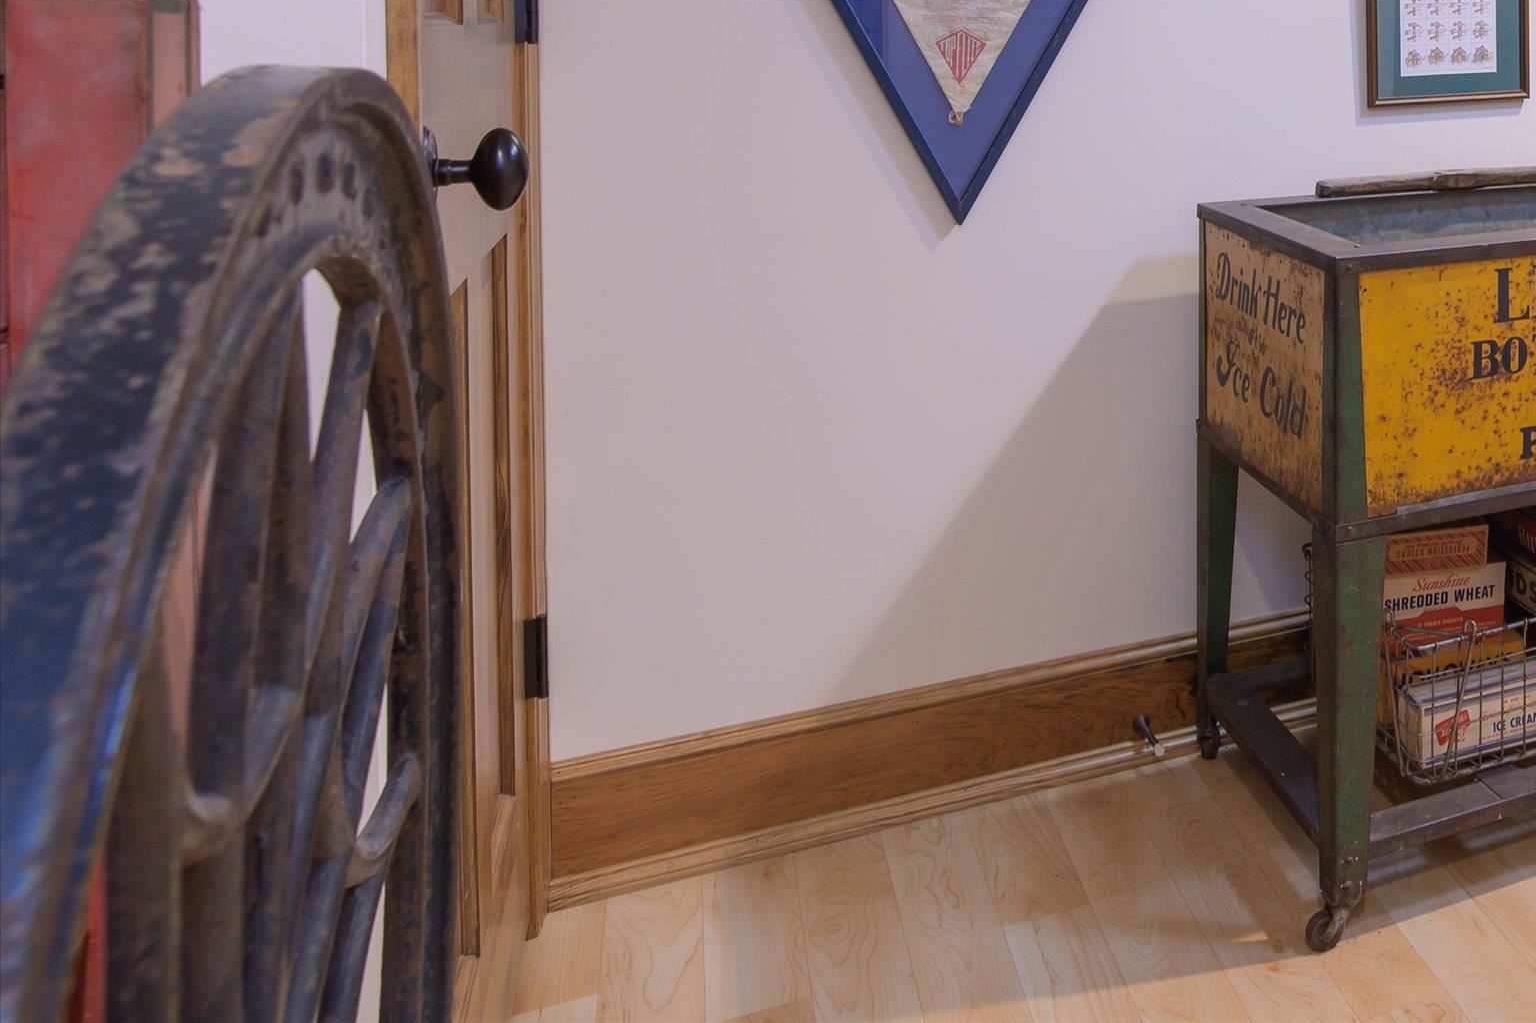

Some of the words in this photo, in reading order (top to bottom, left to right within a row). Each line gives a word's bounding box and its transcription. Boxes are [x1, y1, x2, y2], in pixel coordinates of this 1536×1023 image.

[1215, 252, 1262, 320] Drink
[1262, 274, 1307, 345] Here
[1215, 338, 1251, 404] Ice
[1259, 365, 1308, 440] Cold
[1384, 591, 1449, 613] SHREDDED
[1453, 584, 1496, 603] WHEAT
[1411, 573, 1472, 593] Sunshine
